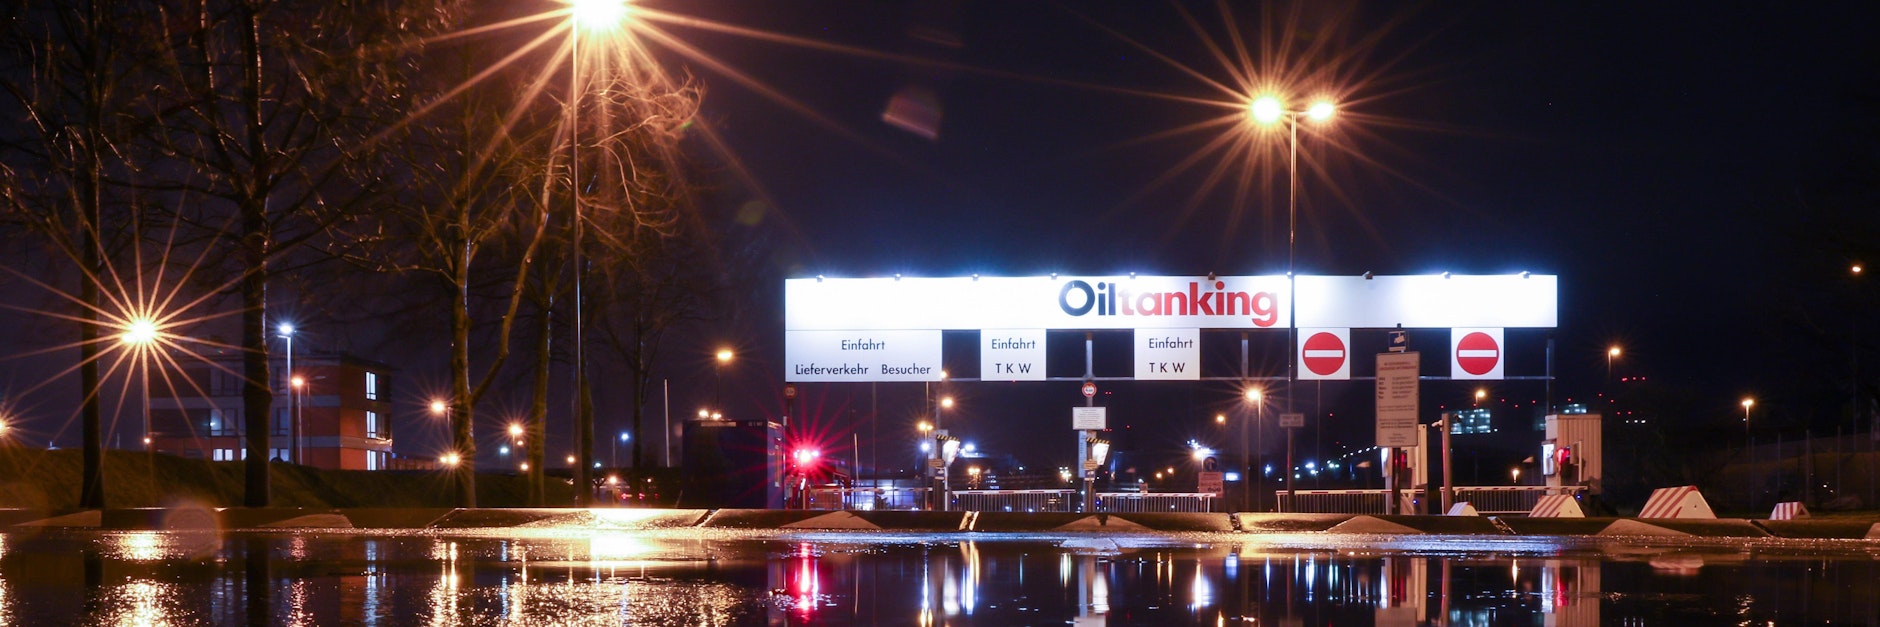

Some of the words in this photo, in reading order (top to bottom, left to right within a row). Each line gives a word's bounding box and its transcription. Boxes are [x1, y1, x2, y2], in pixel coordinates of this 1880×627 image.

[1058, 279, 1278, 328] Oiltanking
[841, 338, 886, 351] Einfahrt
[991, 337, 1036, 350] Einfahrt
[1148, 336, 1194, 349] Einfahrt
[795, 362, 869, 376] Lieferverkehr
[881, 362, 932, 376] Besucher
